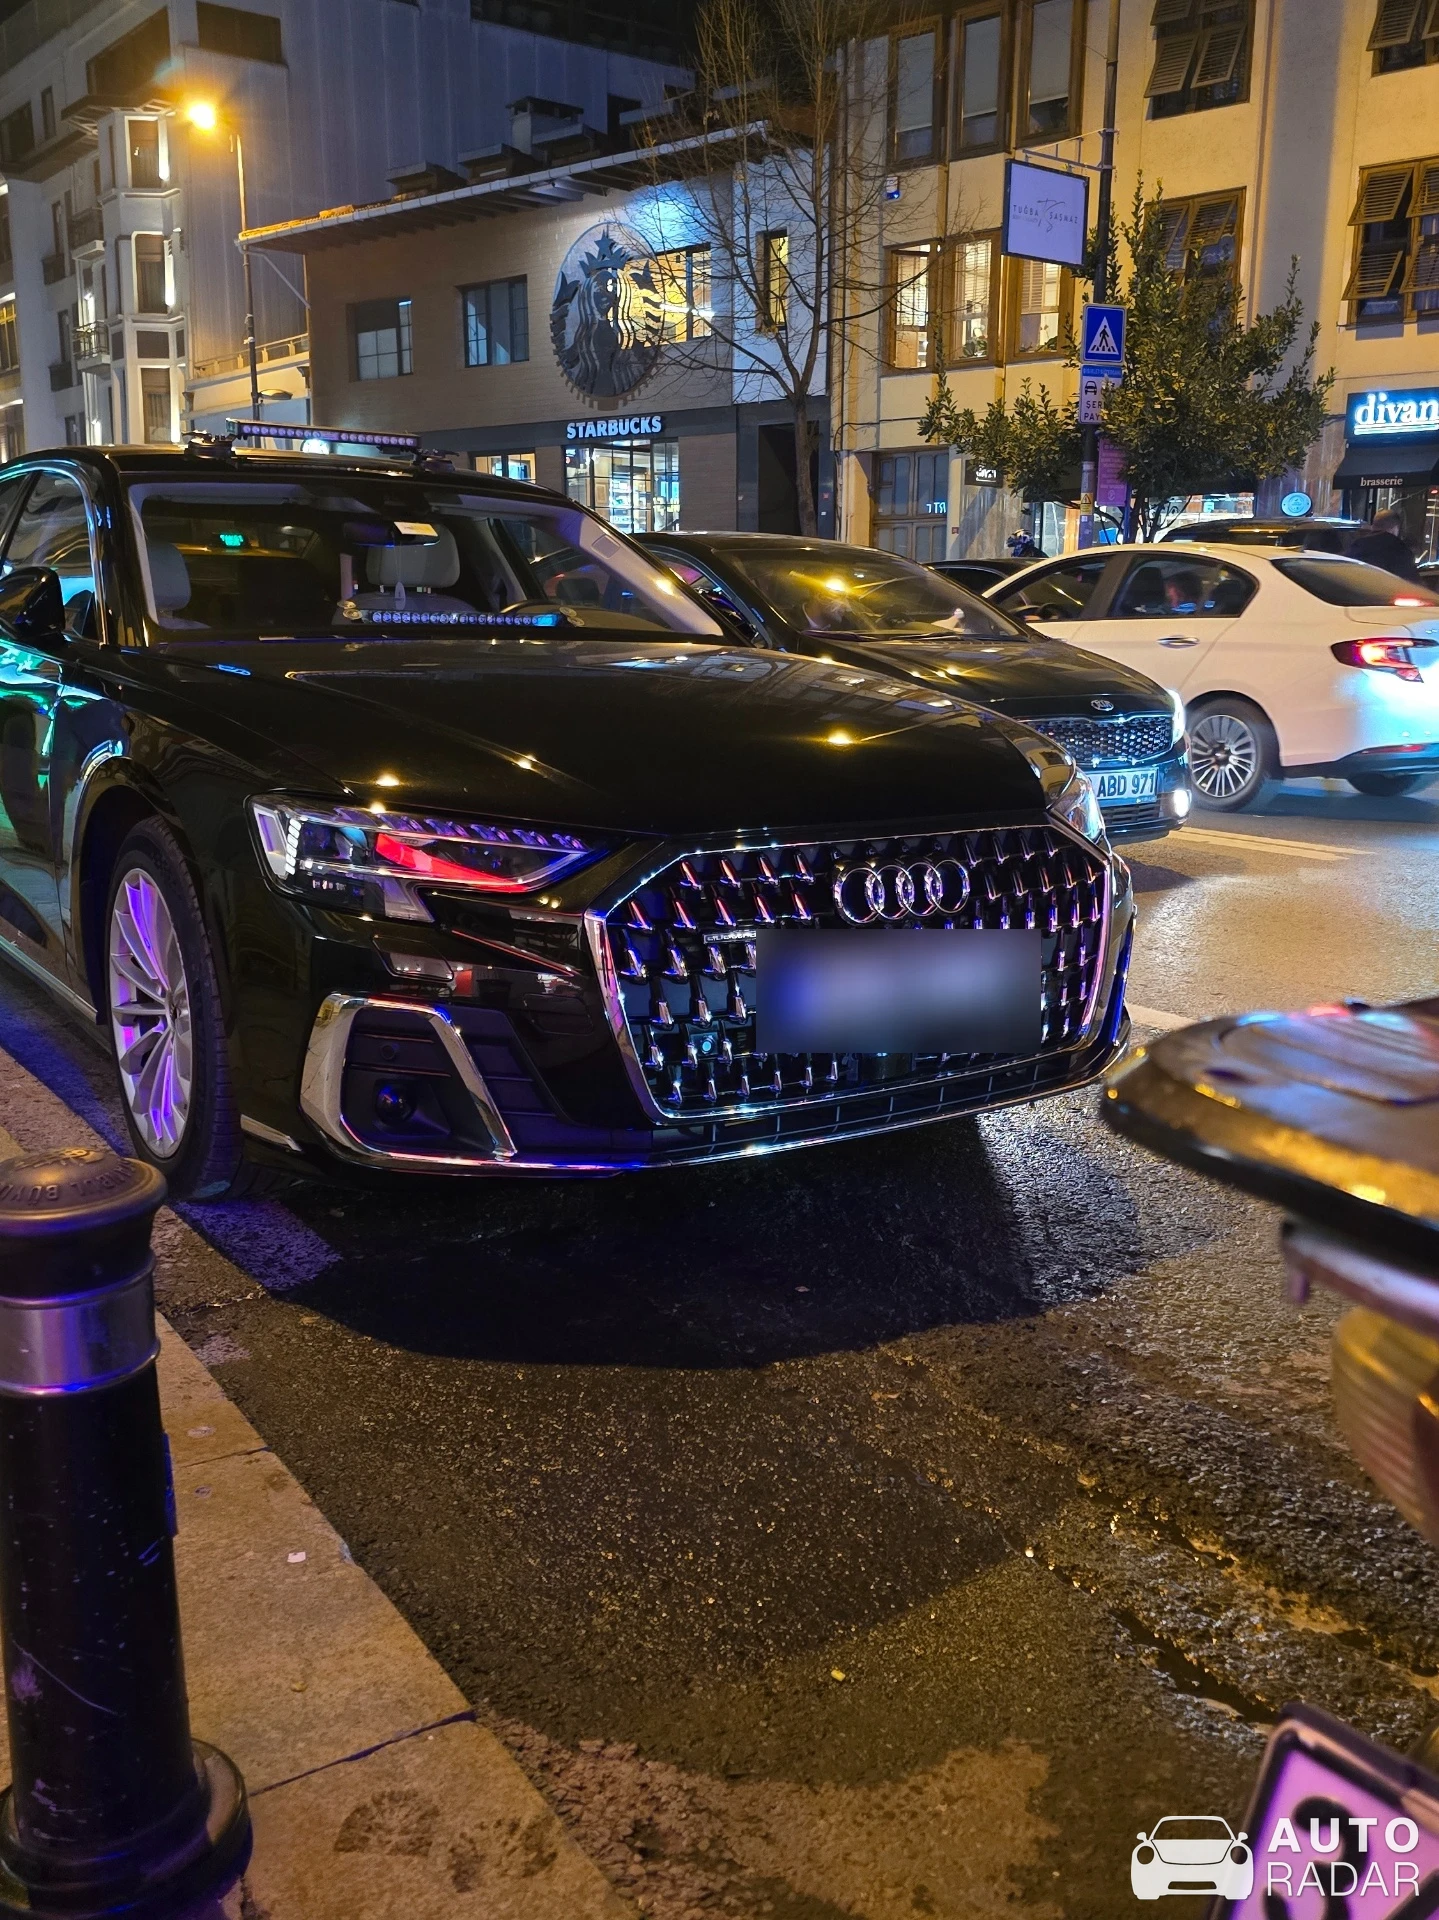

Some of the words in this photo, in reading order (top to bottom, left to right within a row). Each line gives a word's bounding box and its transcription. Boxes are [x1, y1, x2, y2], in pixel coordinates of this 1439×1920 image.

[1013, 205, 1039, 217] TUĞBA
[1086, 400, 1103, 410] ŞER
[1355, 392, 1439, 425] divan
[1083, 412, 1100, 421] PAY
[566, 416, 662, 439] STARBUCKS
[1360, 476, 1403, 487] brasserie
[1097, 775, 1128, 798] ABD
[1131, 773, 1155, 795] 971
